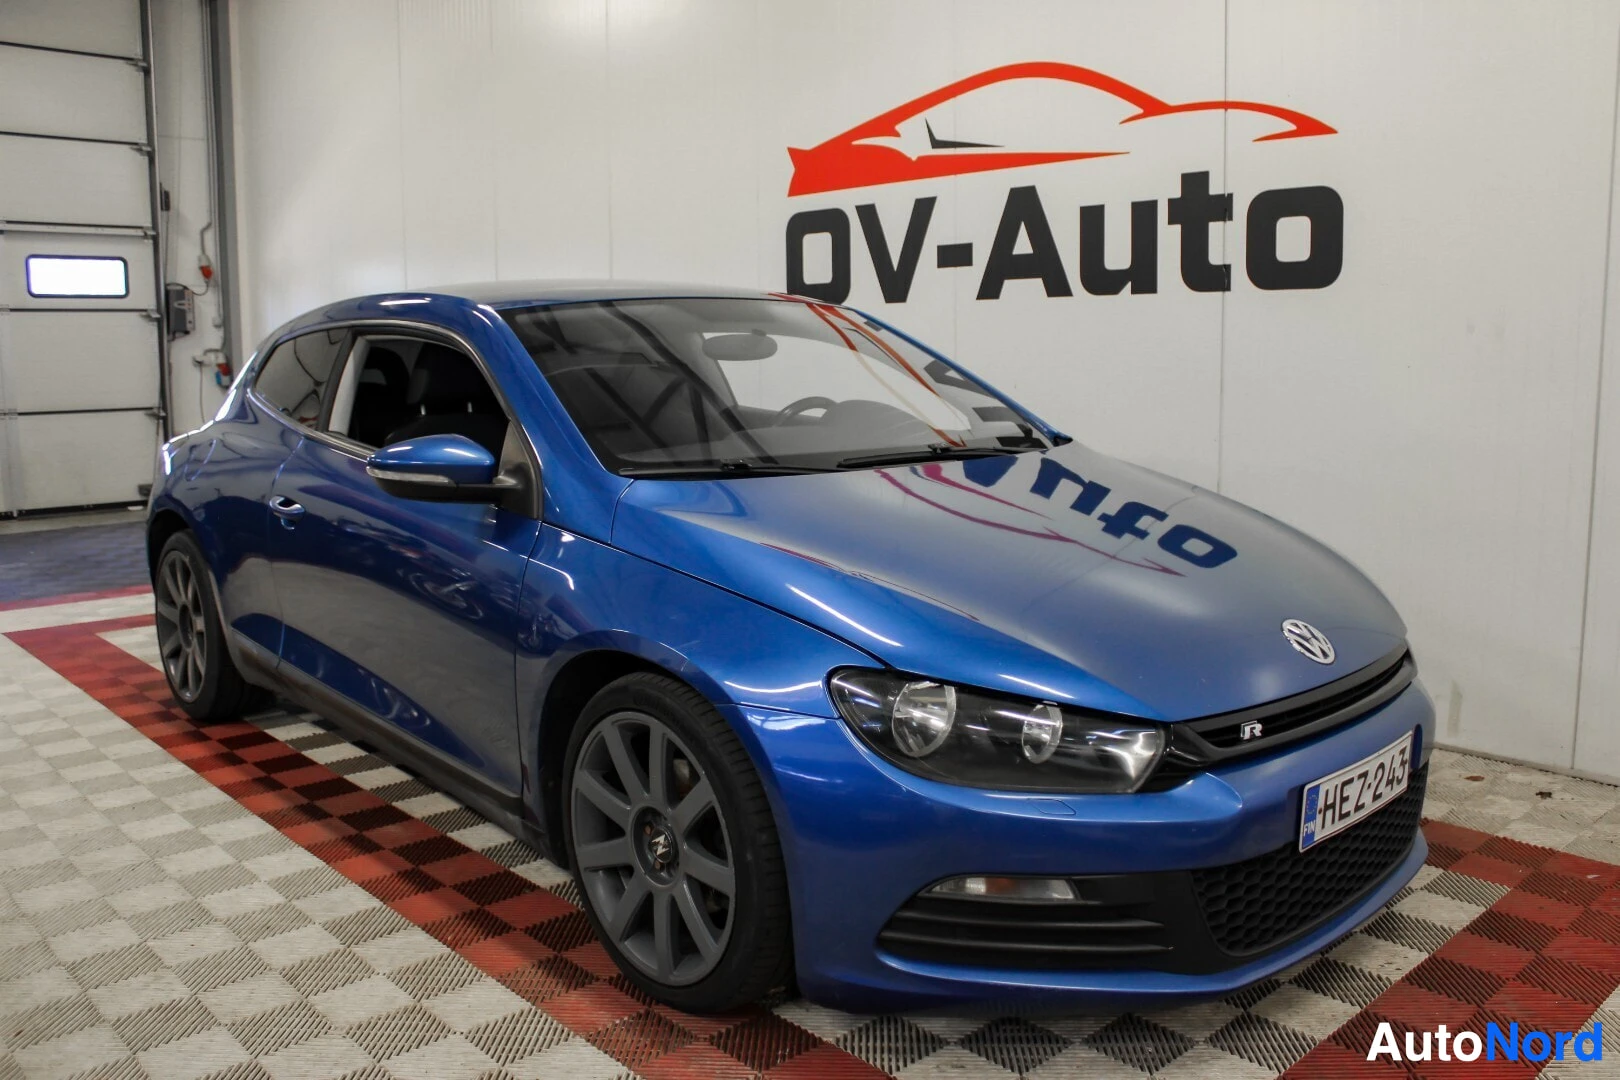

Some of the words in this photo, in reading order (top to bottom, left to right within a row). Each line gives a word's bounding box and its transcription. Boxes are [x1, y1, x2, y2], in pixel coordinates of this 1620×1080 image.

[786, 171, 1344, 304] OV-Auto
[1241, 721, 1263, 740] R
[1321, 744, 1408, 830] HEZ-243
[1303, 819, 1316, 838] FIN
